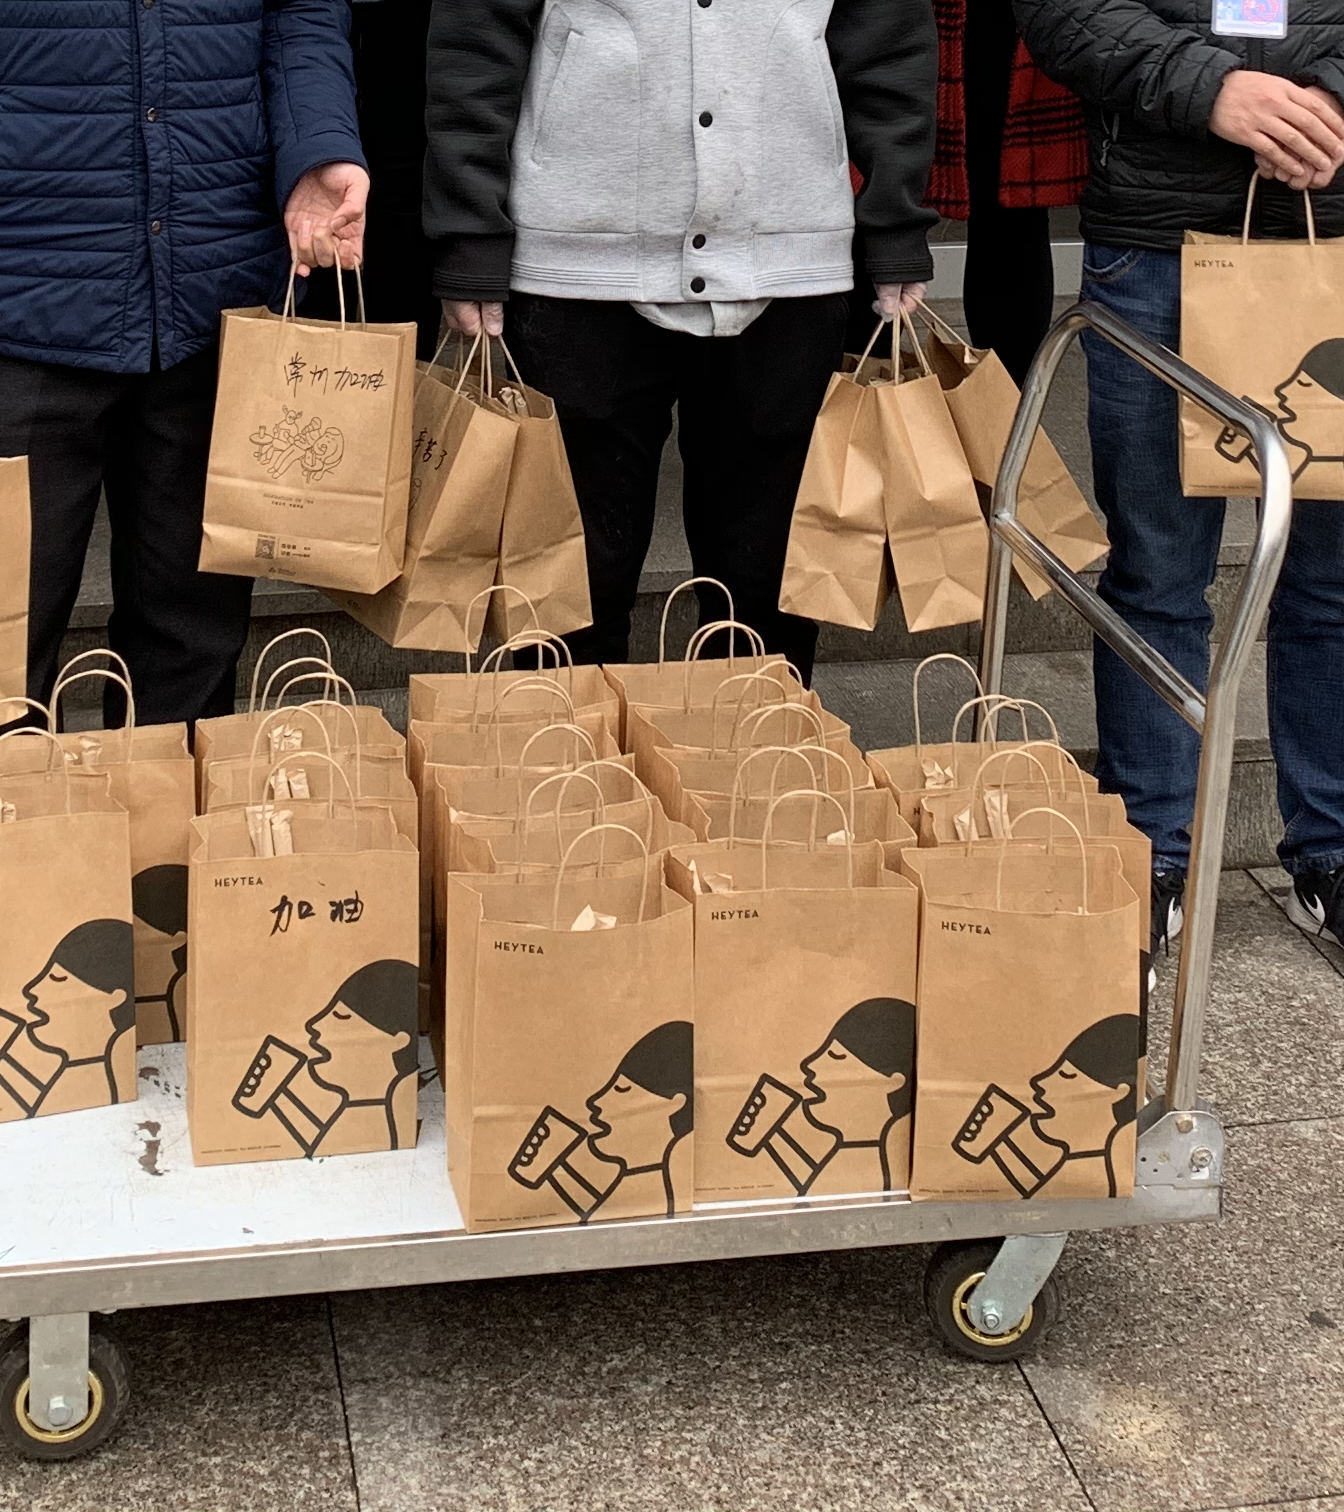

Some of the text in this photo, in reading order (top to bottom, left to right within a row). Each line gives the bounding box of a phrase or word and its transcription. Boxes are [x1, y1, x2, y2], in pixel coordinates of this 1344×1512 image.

[1194, 259, 1235, 268] HEYTEA
[214, 876, 264, 888] HEYTEA
[711, 909, 760, 921] HEYTEA
[941, 920, 992, 935] HEYTEA
[494, 940, 544, 955] HEYTEA
